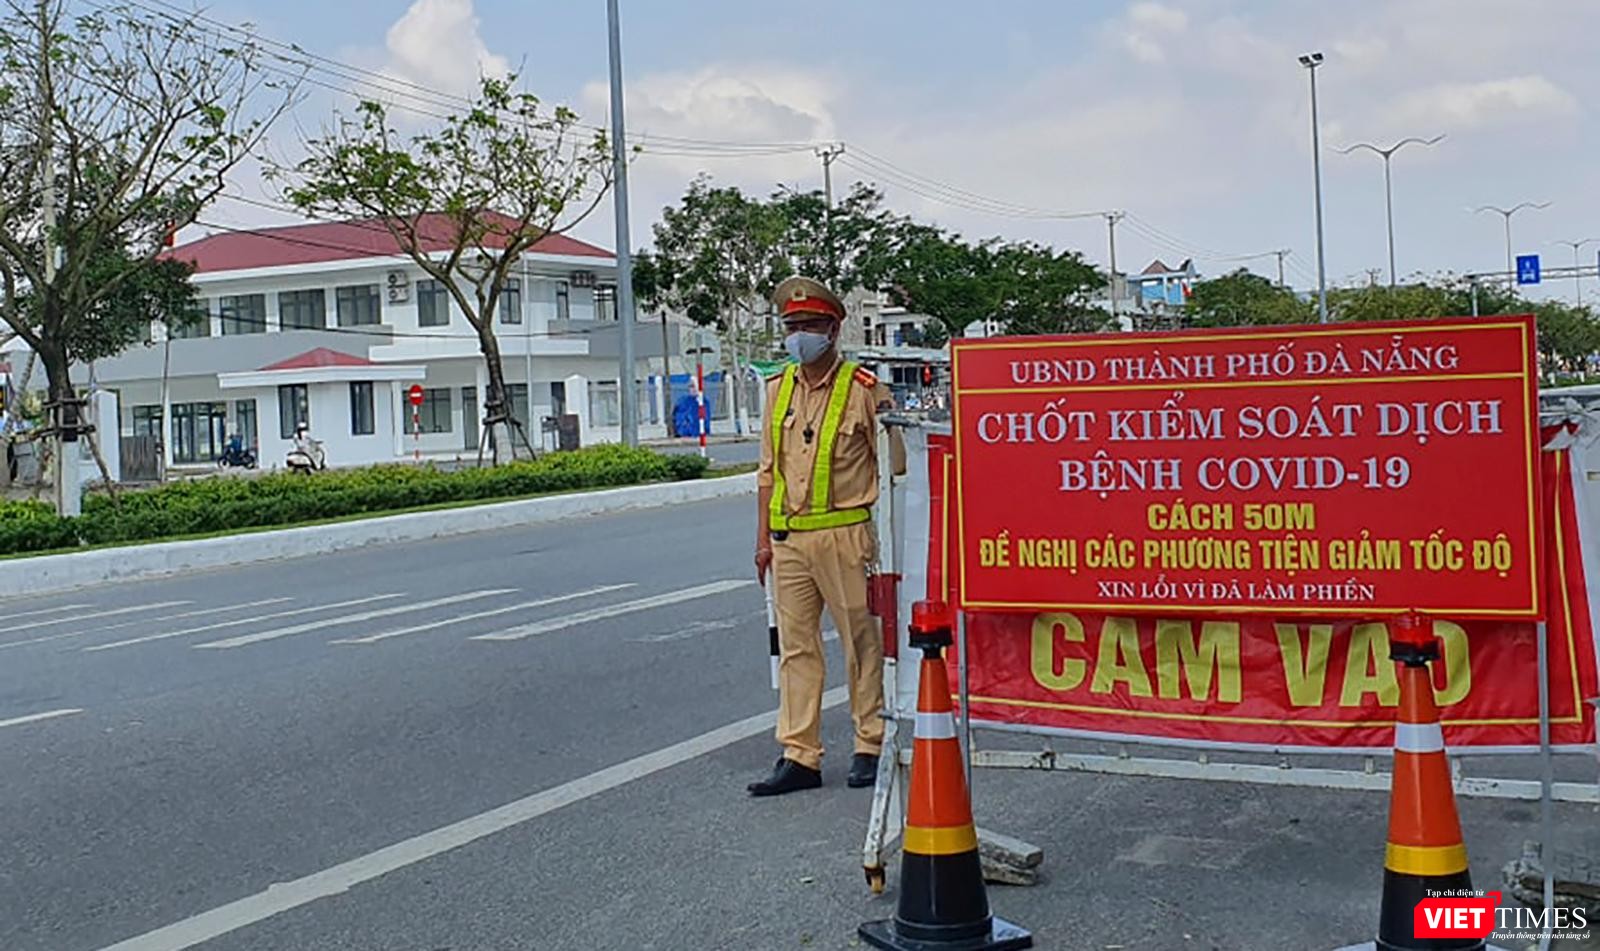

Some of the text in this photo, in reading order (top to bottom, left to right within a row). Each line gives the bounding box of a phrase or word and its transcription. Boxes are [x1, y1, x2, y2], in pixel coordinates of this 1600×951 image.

[1010, 335, 1460, 383] UBND THÀNH PHỐ ĐÀ NẴNG
[977, 391, 1503, 444] CHỐT KIỂM SOÁT DỊCH
[1059, 450, 1411, 499] BỆNH COVID-19
[1148, 498, 1315, 530] CÁCH 50M
[979, 528, 1513, 577] ĐỀ NGHỊ CÁC PHƯƠNG TIỆN GIẢM TỐC ĐỘ
[1097, 582, 1135, 597] XIN
[1184, 579, 1206, 598] VÌ
[1212, 579, 1242, 599] ĐÃ
[1248, 579, 1295, 600] LÀM
